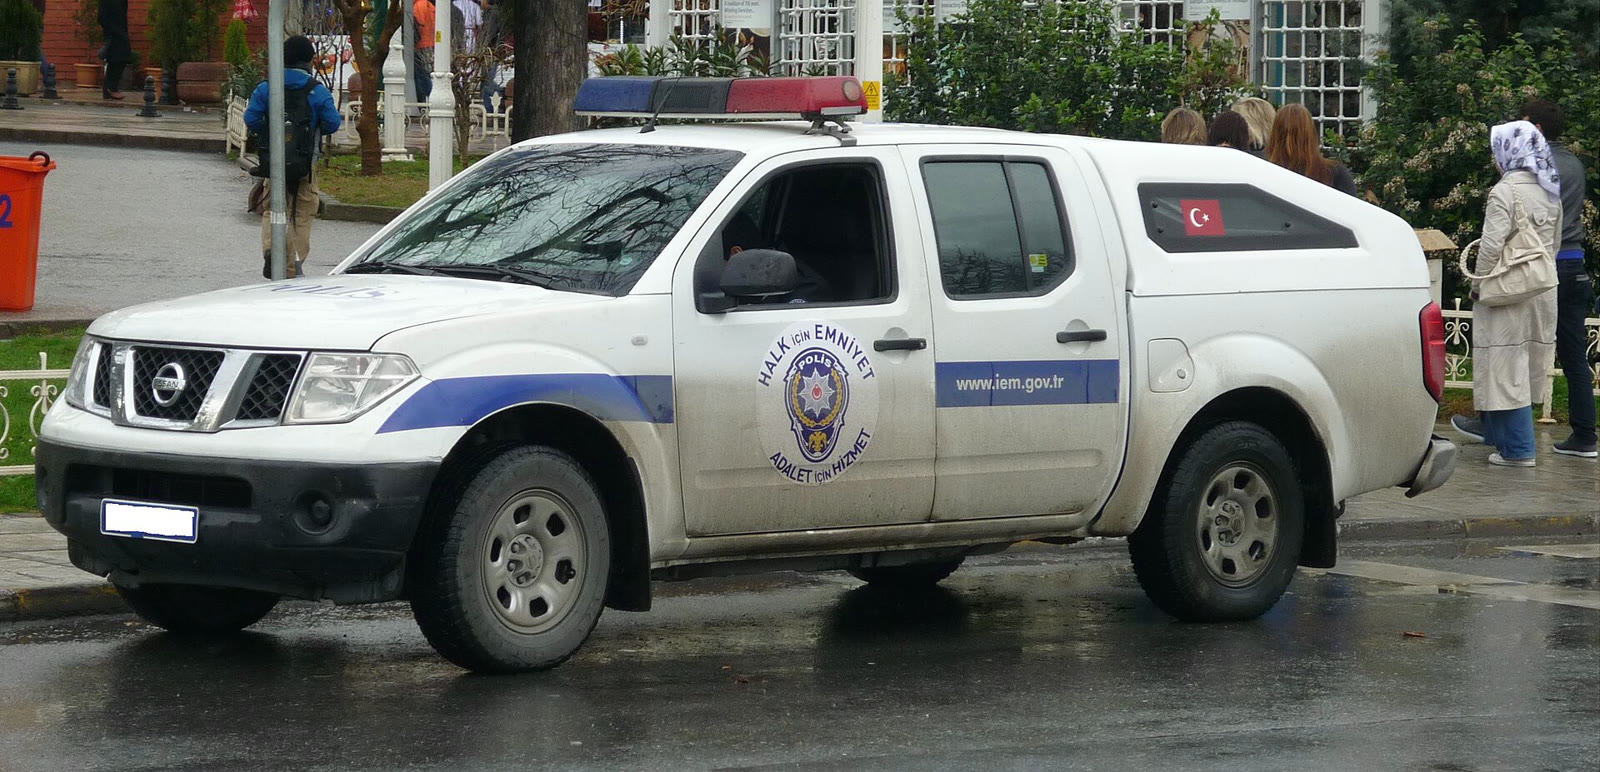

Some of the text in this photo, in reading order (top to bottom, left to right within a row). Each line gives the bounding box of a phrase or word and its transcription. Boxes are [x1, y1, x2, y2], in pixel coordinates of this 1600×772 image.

[758, 336, 791, 387] HALK
[815, 324, 875, 380] EMNİYET
[799, 353, 831, 371] POLİS
[956, 373, 1064, 393] www.iem.gov.tr
[769, 451, 813, 484] ADALET
[832, 427, 871, 476] HİZMET
